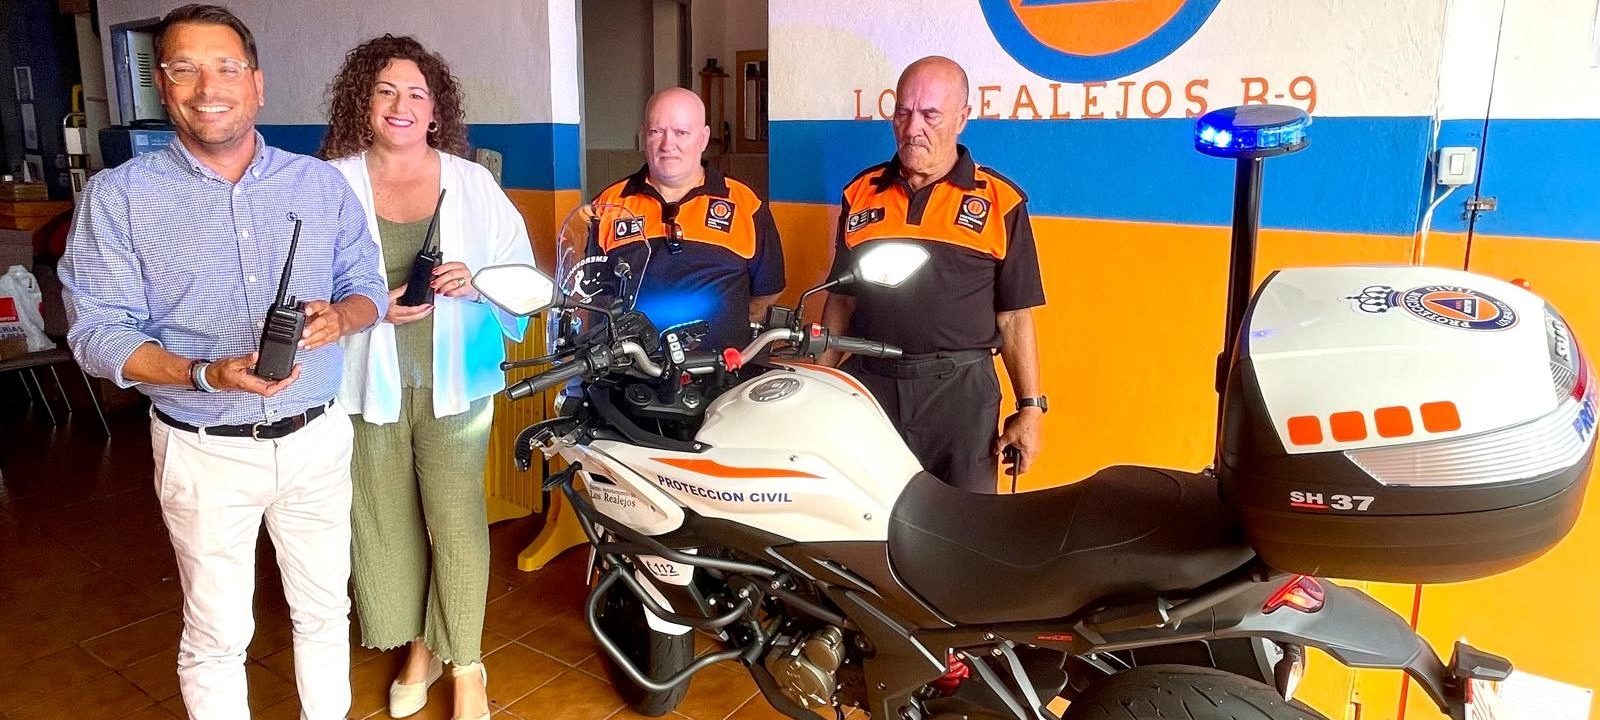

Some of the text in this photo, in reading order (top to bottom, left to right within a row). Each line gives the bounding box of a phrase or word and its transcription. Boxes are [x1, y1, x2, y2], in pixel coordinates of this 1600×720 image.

[854, 88, 897, 121] LO
[978, 79, 1208, 119] EALEJOS
[657, 474, 792, 503] PROTECCION CIVIL
[590, 490, 601, 500] Los
[604, 492, 636, 508] Realejos
[1290, 491, 1375, 511] SH 37
[654, 563, 677, 574] 112
